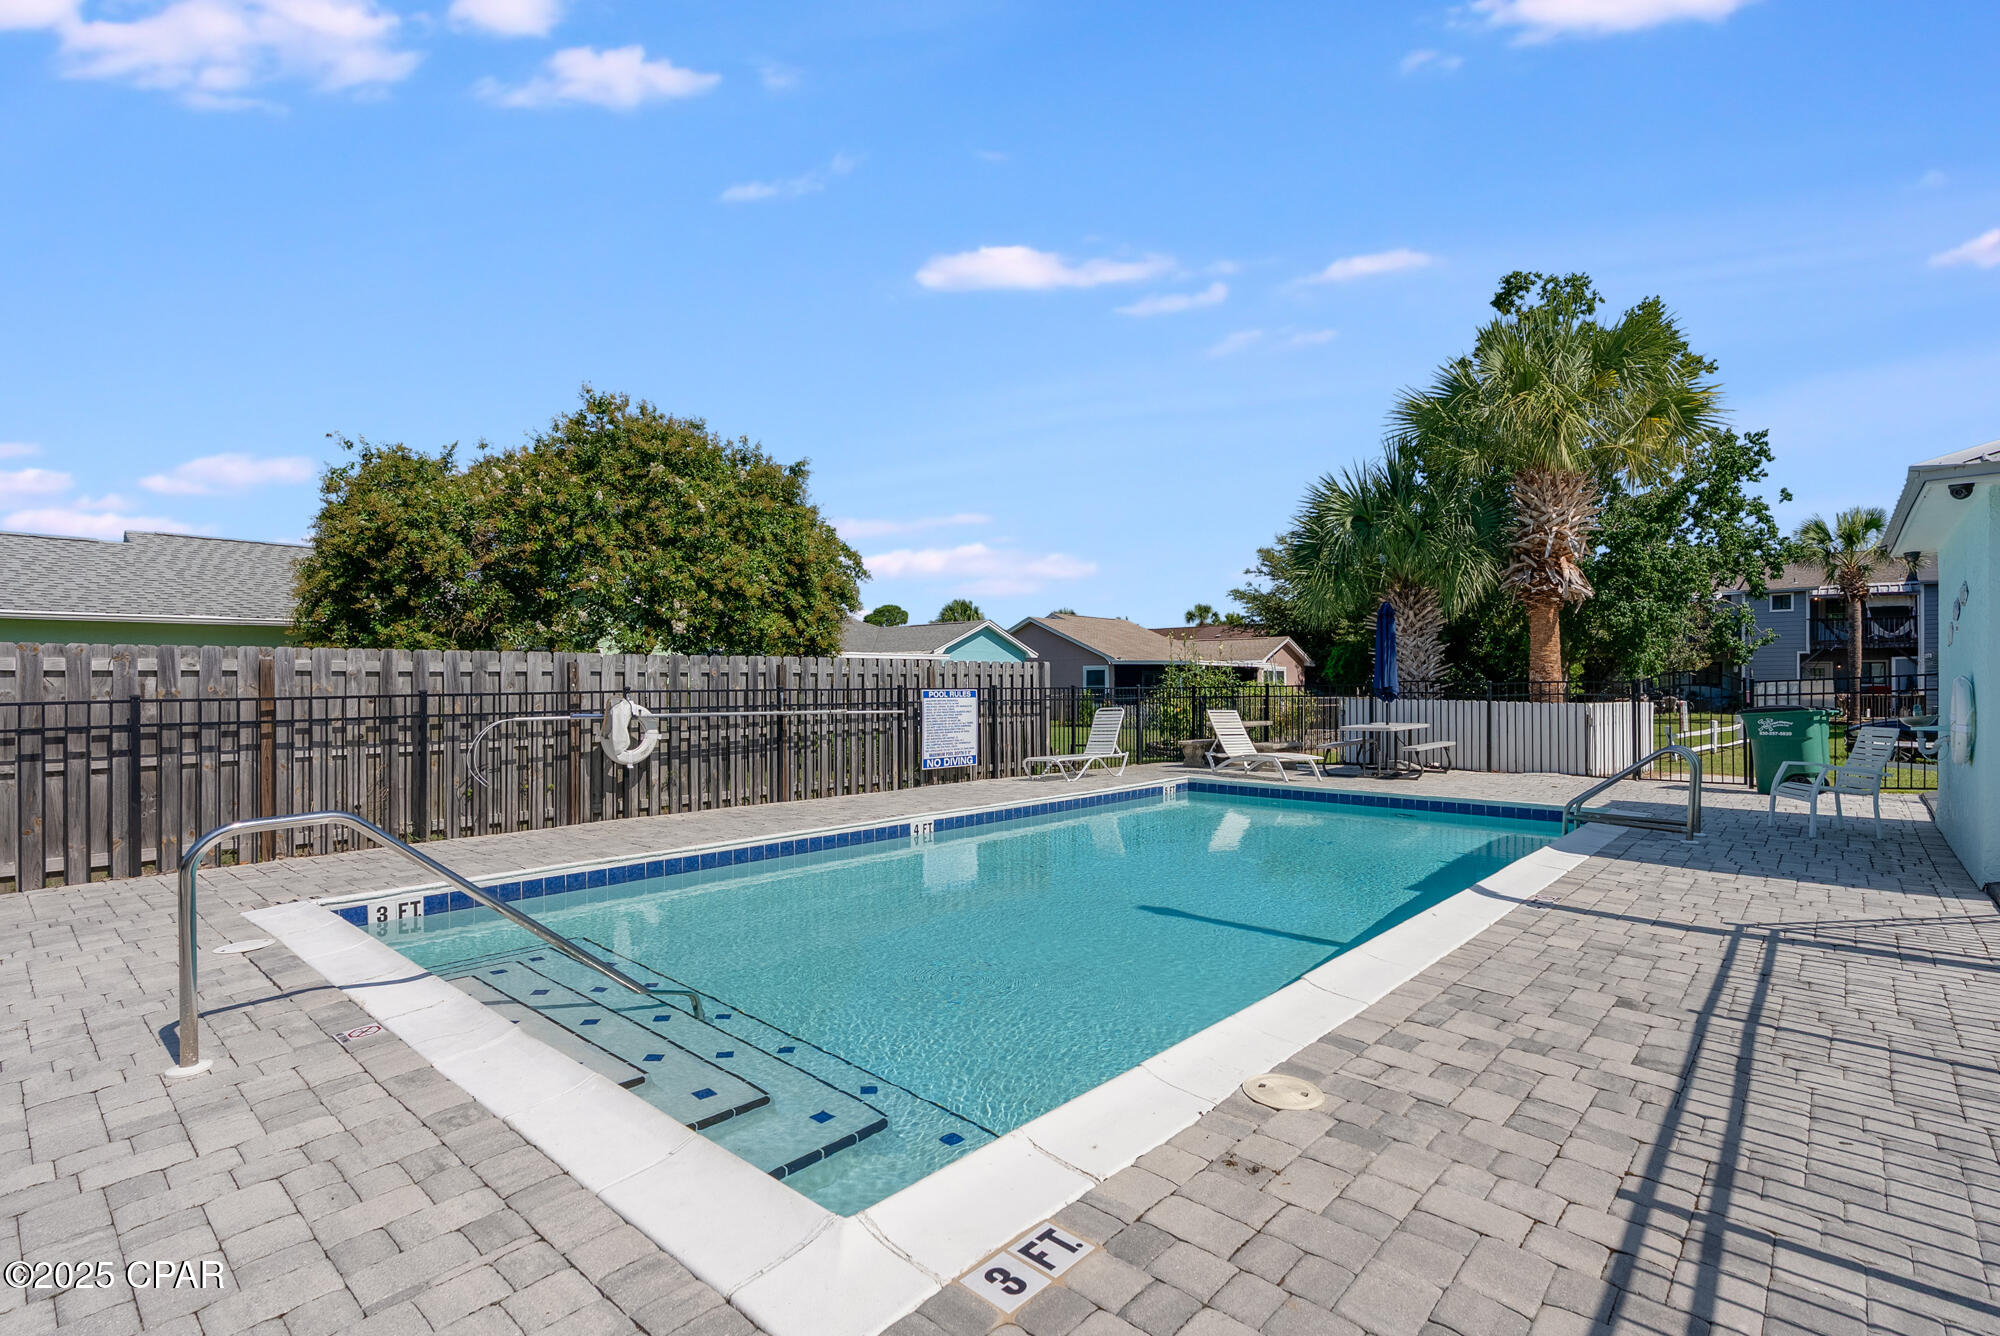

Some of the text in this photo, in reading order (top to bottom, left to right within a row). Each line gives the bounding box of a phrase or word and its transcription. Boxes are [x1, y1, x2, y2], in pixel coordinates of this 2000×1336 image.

[928, 690, 972, 698] POOL RULES
[926, 756, 974, 769] NO DIVING
[913, 823, 920, 836] 4
[376, 900, 422, 923] 3 FT.
[984, 1227, 1083, 1295] 3 FT.
